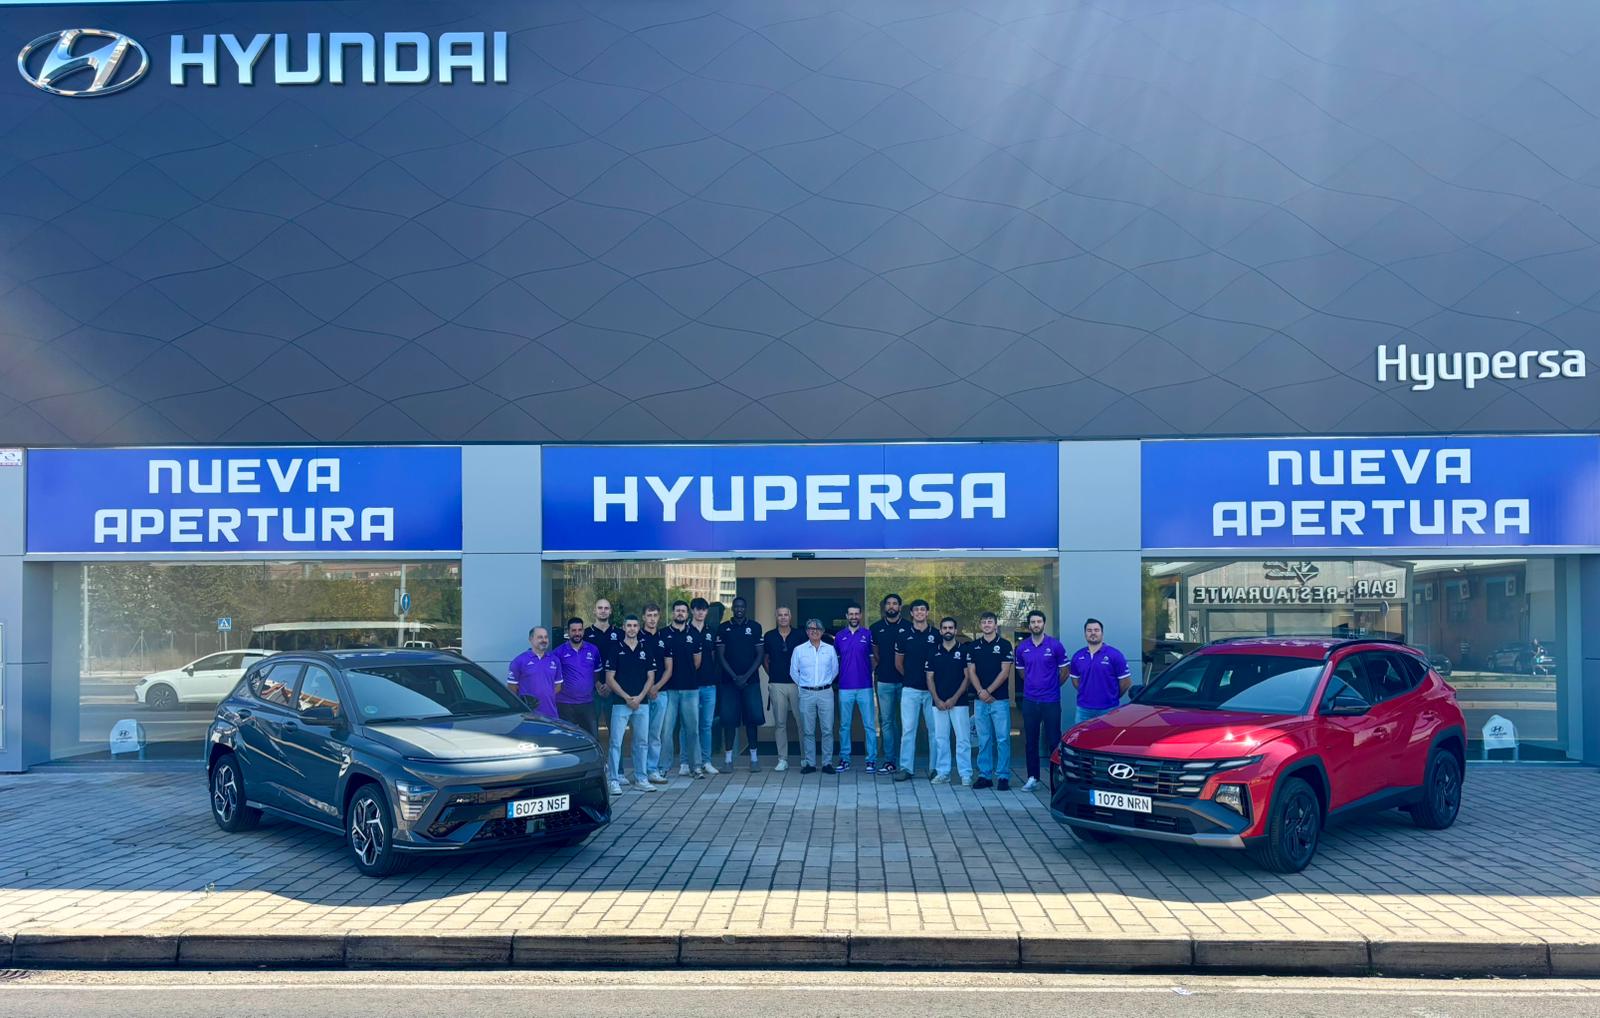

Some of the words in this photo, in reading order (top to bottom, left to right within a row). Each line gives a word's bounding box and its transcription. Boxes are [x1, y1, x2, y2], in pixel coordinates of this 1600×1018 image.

[170, 32, 508, 86] HYUNDAI
[1377, 344, 1586, 391] Hyupersa
[148, 458, 340, 494] NUEVA
[1268, 448, 1472, 486] NUEVA
[593, 472, 1006, 522] HYUPERSA
[94, 507, 394, 544] APERTURA
[1212, 498, 1530, 537] APERTURA
[515, 801, 544, 815] 6073
[547, 797, 567, 810] NSF
[1098, 793, 1124, 807] 1078
[1127, 797, 1149, 810] NRN
